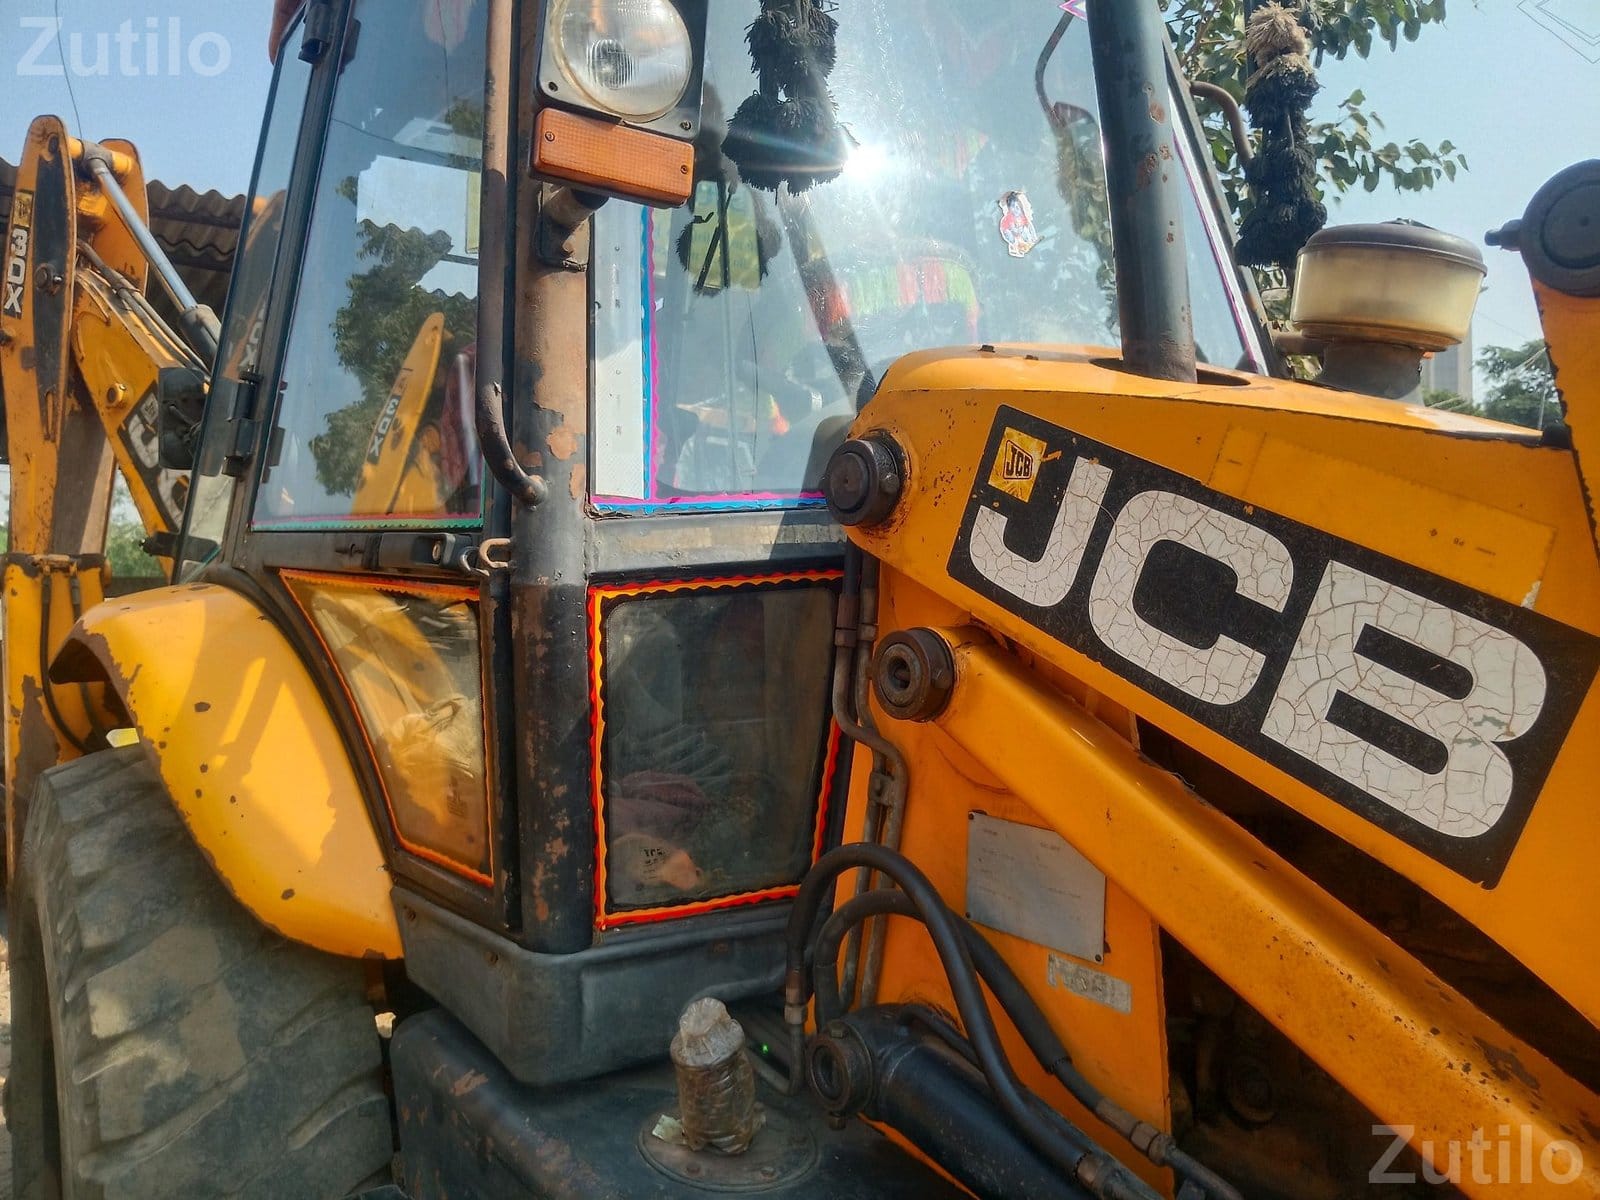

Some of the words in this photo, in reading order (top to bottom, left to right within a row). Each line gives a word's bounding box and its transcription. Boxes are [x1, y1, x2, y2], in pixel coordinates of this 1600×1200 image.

[4, 228, 28, 313] 3DX
[1005, 445, 1031, 476] JCB
[969, 456, 1547, 837] JCB
